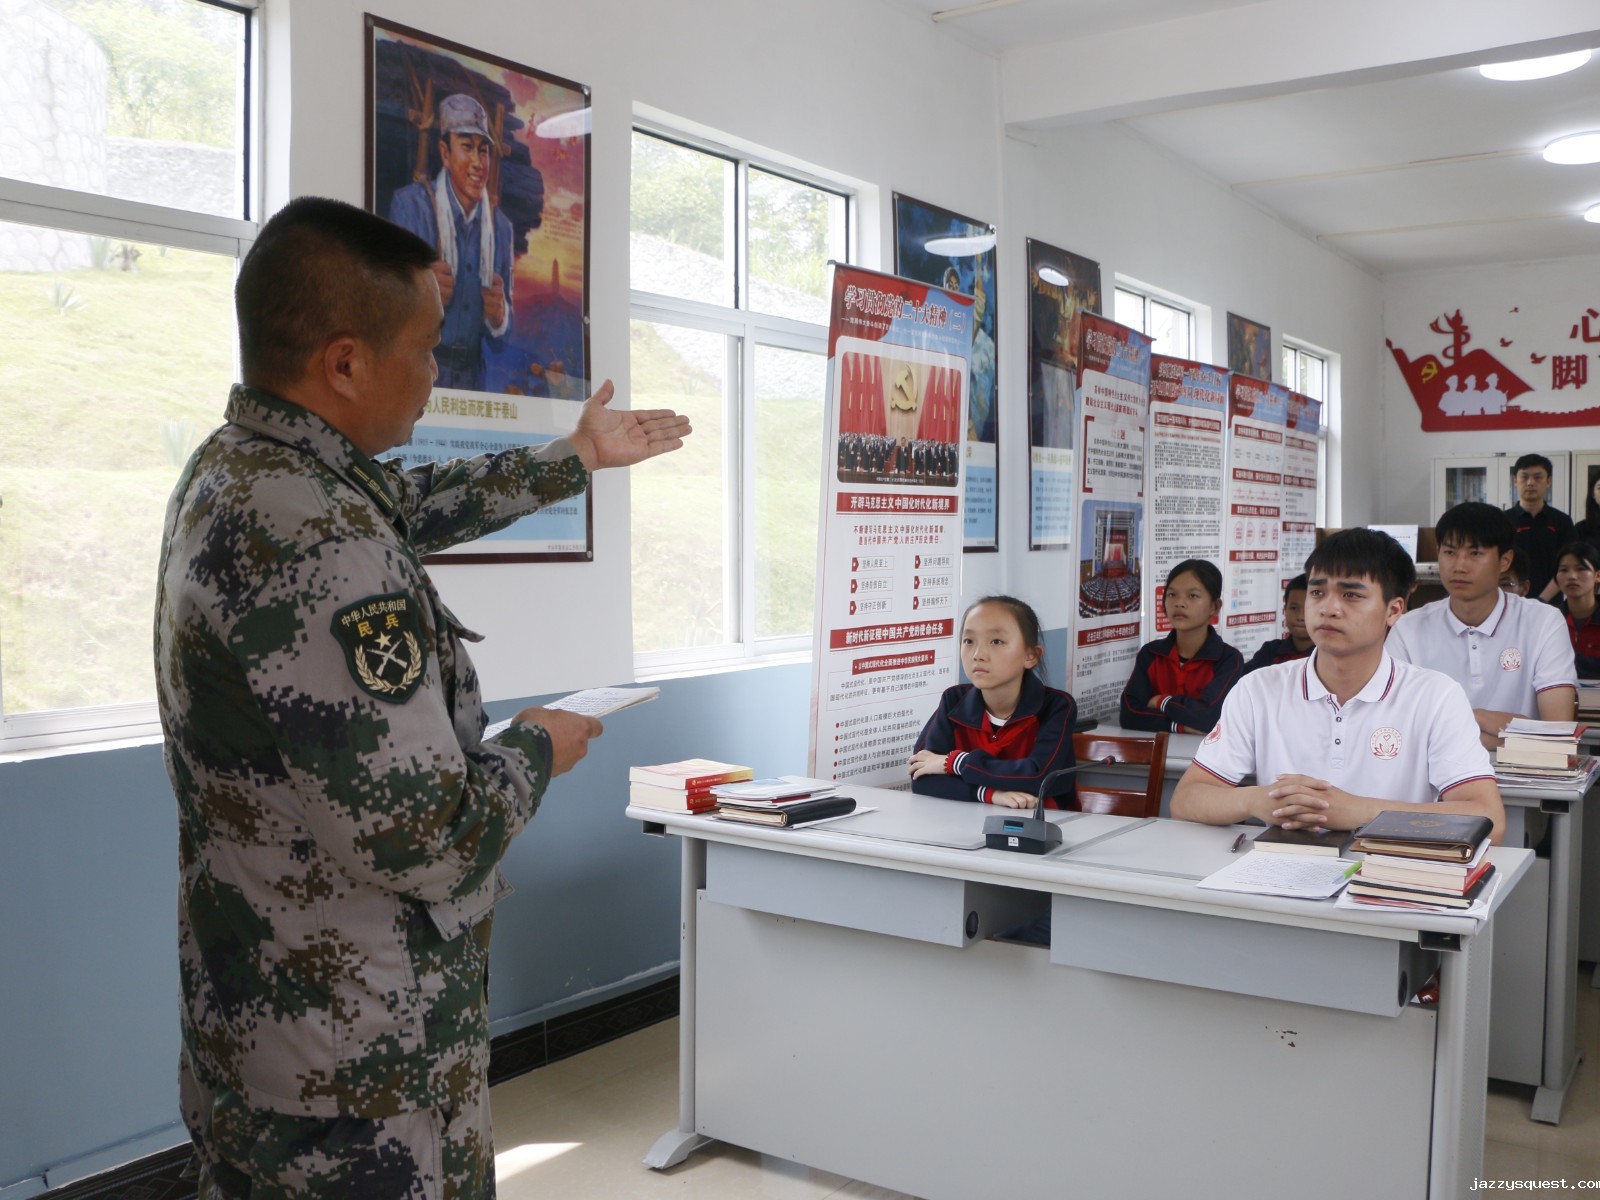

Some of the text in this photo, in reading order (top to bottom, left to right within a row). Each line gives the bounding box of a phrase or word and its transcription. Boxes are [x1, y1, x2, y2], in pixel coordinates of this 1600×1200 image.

[1552, 355, 1588, 390] 脚
[850, 496, 950, 511] 开辟马克思主义中国化时代化新境界
[862, 557, 889, 568] 坚持人民至上
[923, 556, 950, 566] 坚持问题导向
[922, 576, 949, 586] 坚持系统观念
[341, 599, 407, 628] 中华人民共和国
[859, 601, 887, 611] 坚持守正创新
[357, 613, 400, 638] 民兵
[845, 623, 944, 645] 新时代新征程中国共产党的使命任务
[840, 708, 914, 728] 中国式现代化是人口规模巨大的现代化
[837, 744, 914, 766] 中国式现代化是人与自然和谐共生的现
[836, 758, 909, 780] 中国式现代化是走和平发展道路的现
